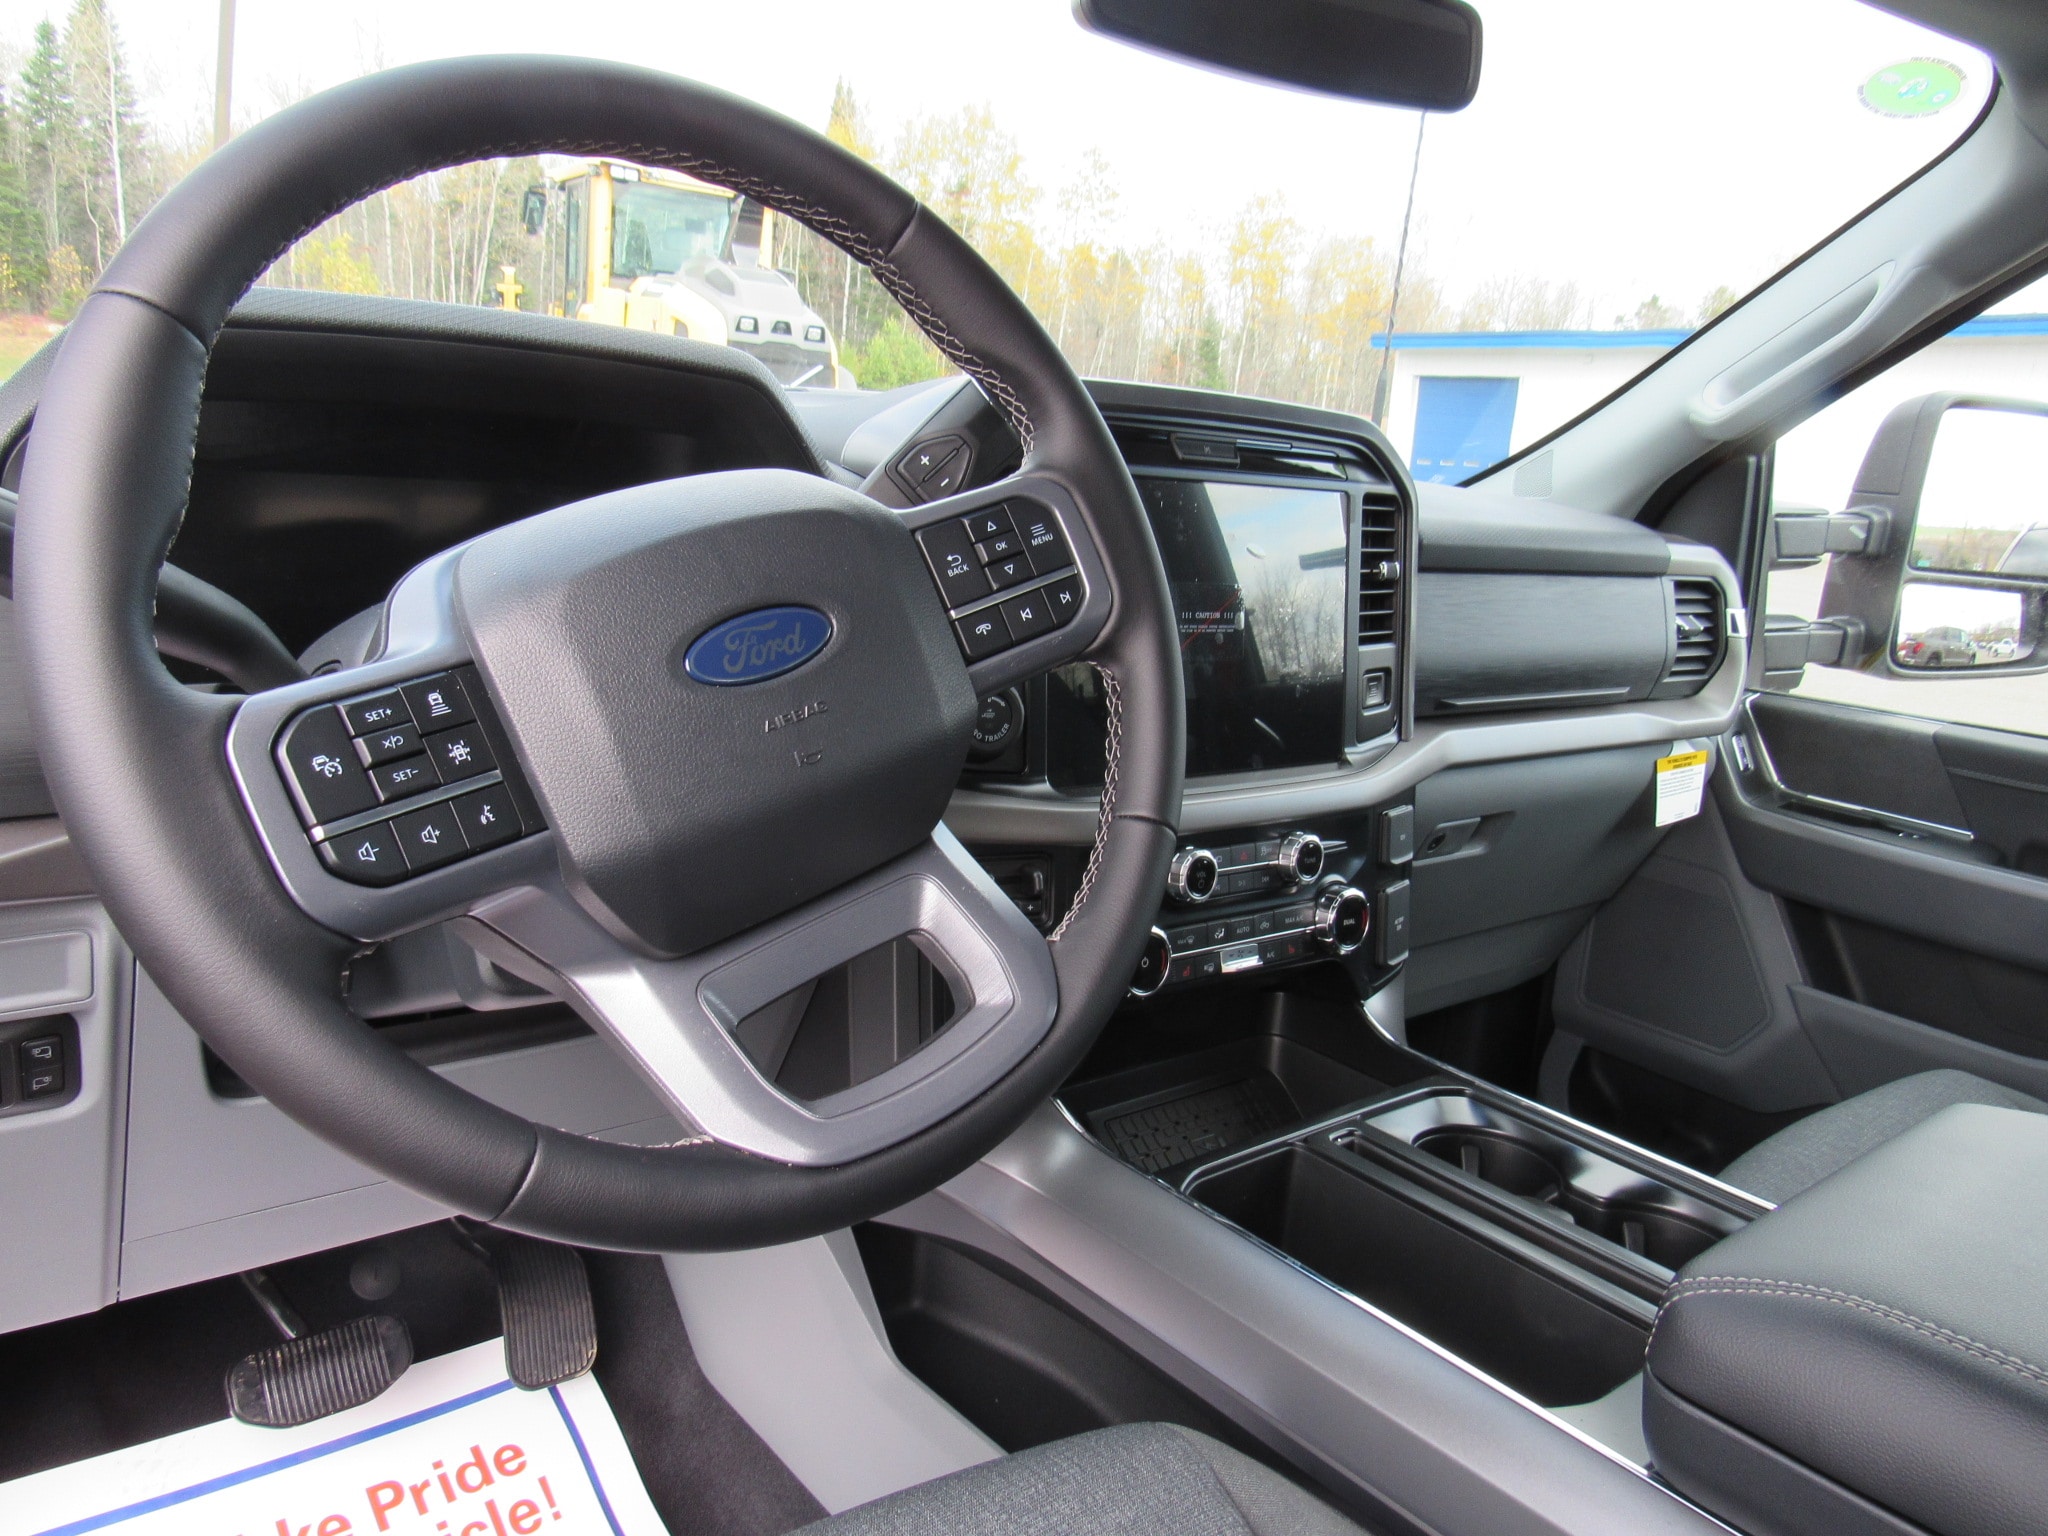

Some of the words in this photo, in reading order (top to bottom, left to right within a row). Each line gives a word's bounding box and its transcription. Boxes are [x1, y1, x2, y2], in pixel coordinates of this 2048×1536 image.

[995, 541, 1008, 551] OK
[1031, 533, 1054, 546] MENU
[947, 564, 970, 578] BACK
[1195, 611, 1221, 619] CAUTION
[723, 619, 807, 674] Ford
[365, 708, 393, 723] SET+
[984, 722, 1011, 743] TRAILER
[392, 768, 419, 783] SET-
[1236, 926, 1250, 934] AUTO
[1266, 951, 1275, 959] A/C
[365, 1444, 527, 1533] Pride
